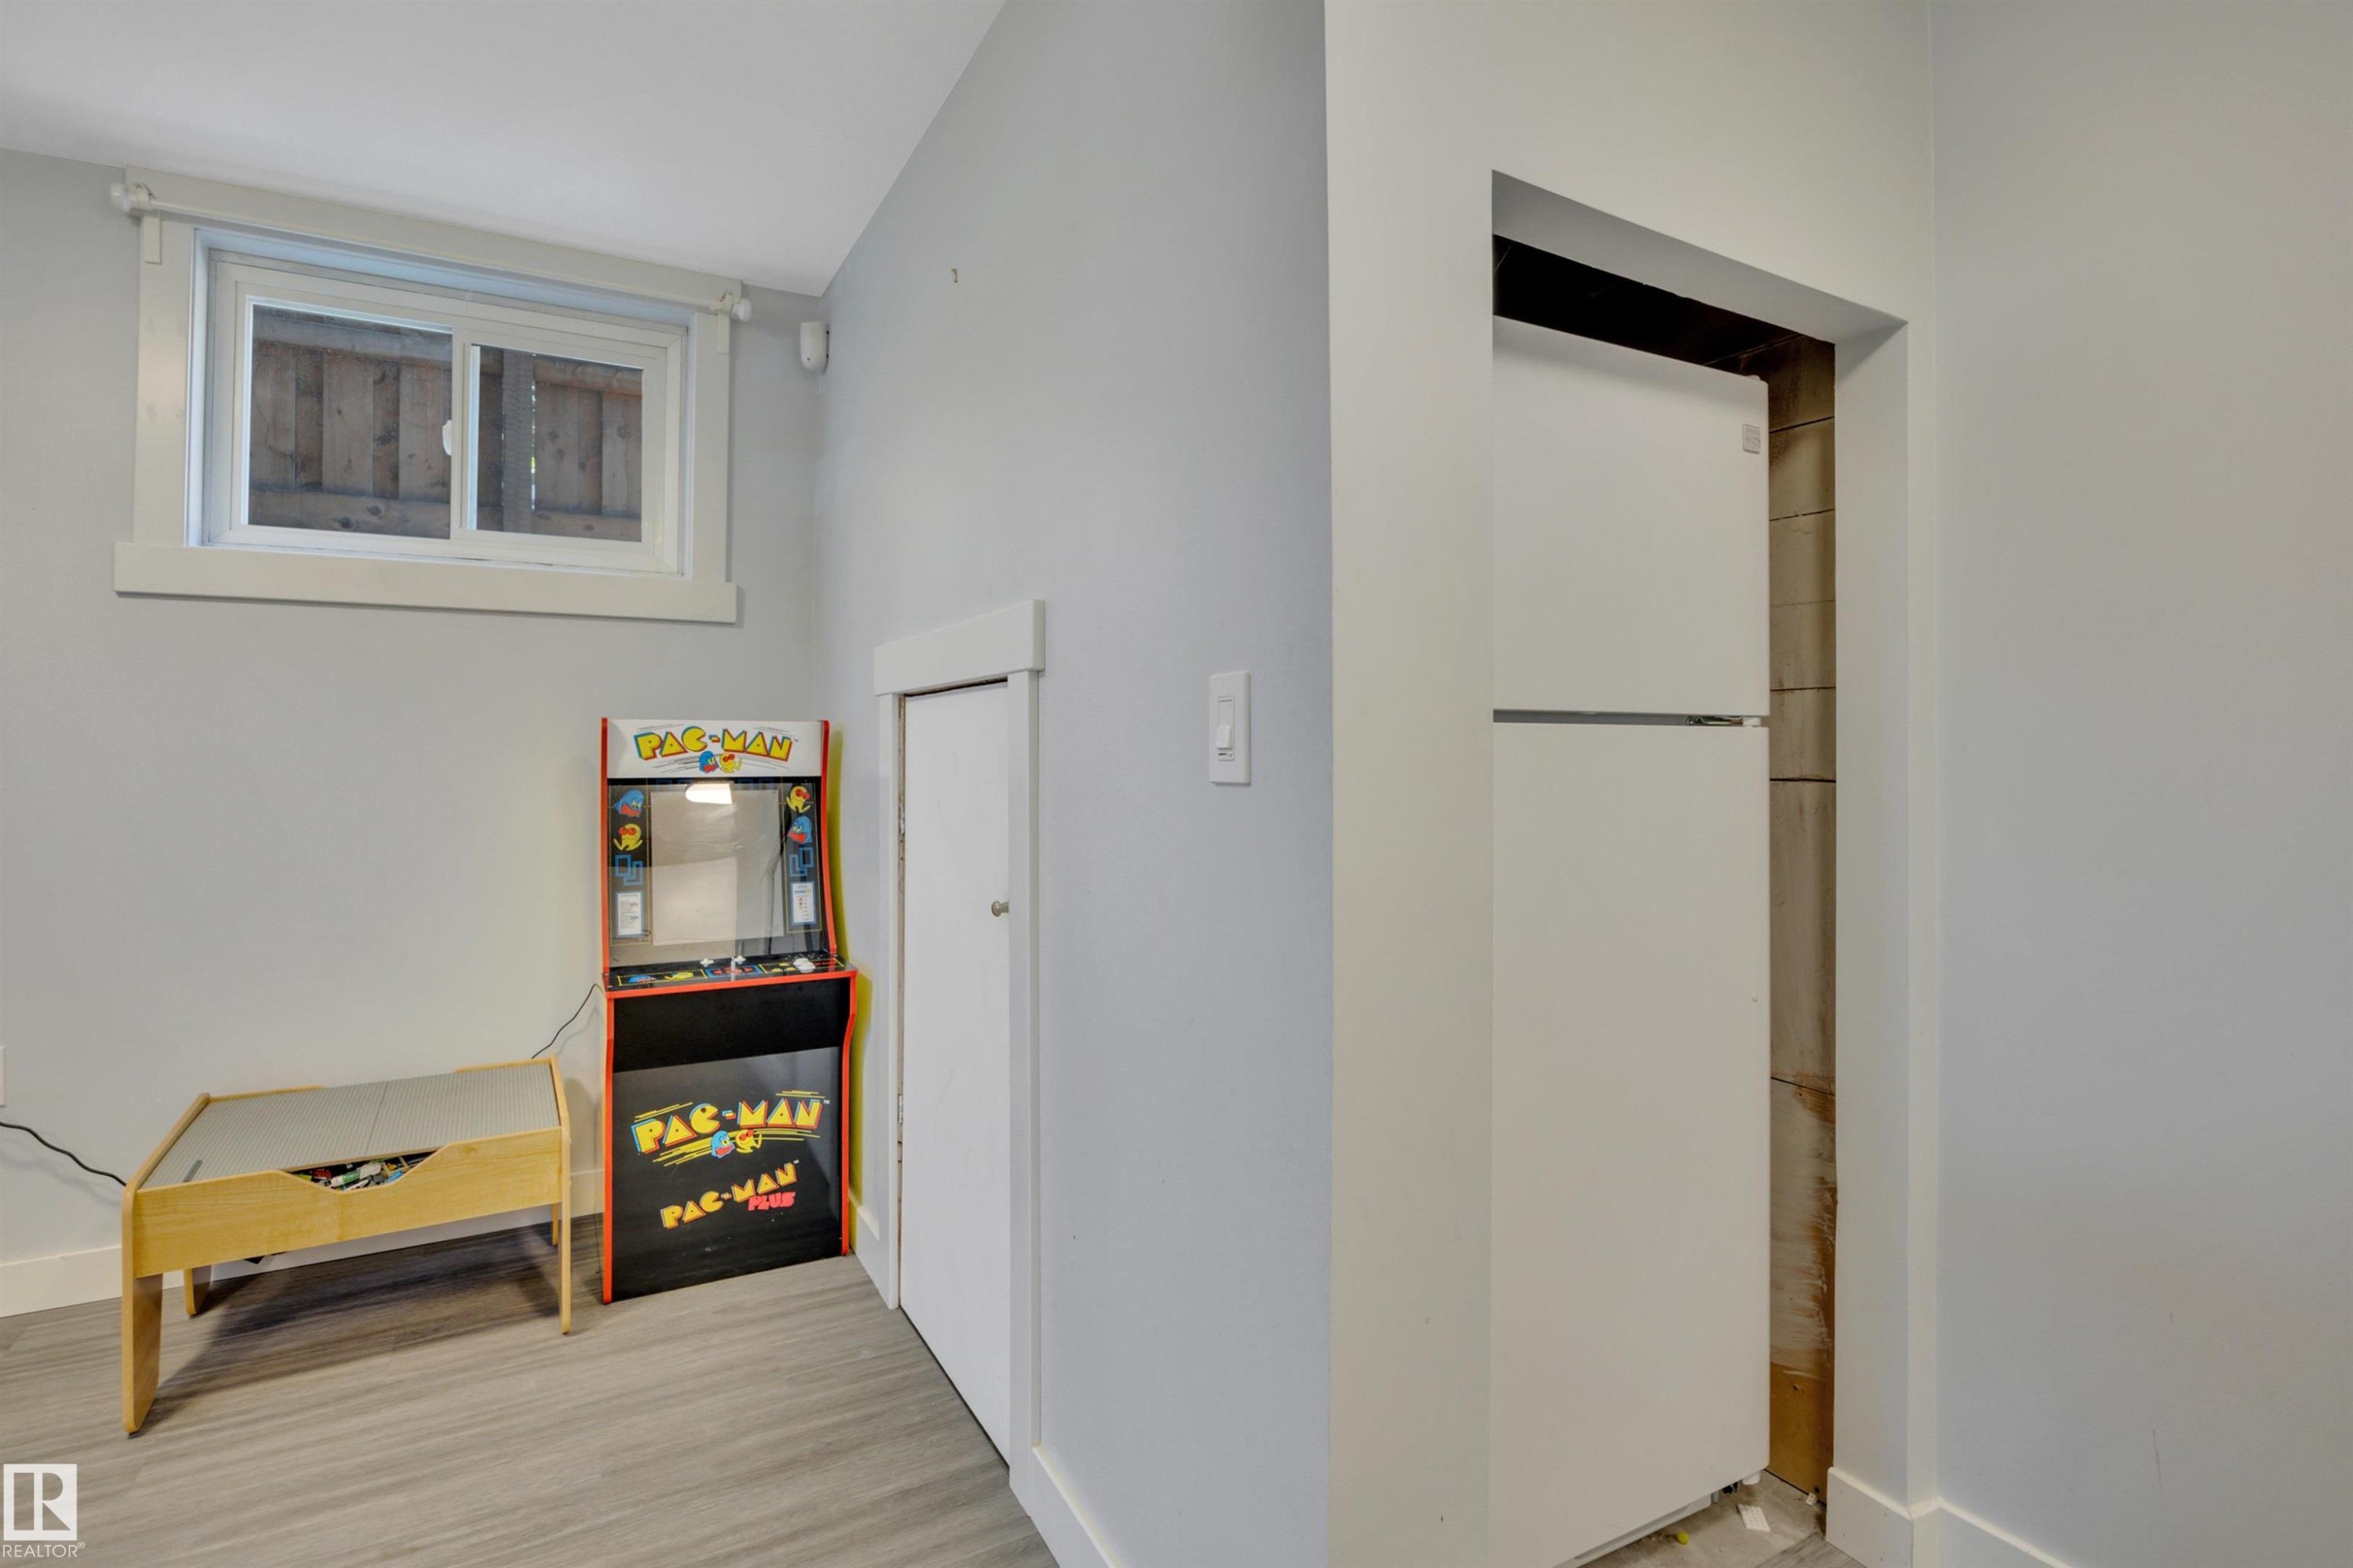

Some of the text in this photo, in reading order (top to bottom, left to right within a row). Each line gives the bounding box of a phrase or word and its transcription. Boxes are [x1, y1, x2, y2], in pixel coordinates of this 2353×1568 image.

[634, 726, 792, 762] PAC-MAN
[631, 1099, 822, 1154] PAC-MAN
[660, 1162, 797, 1229] PAC-MAN
[747, 1191, 796, 1211] PLUS
